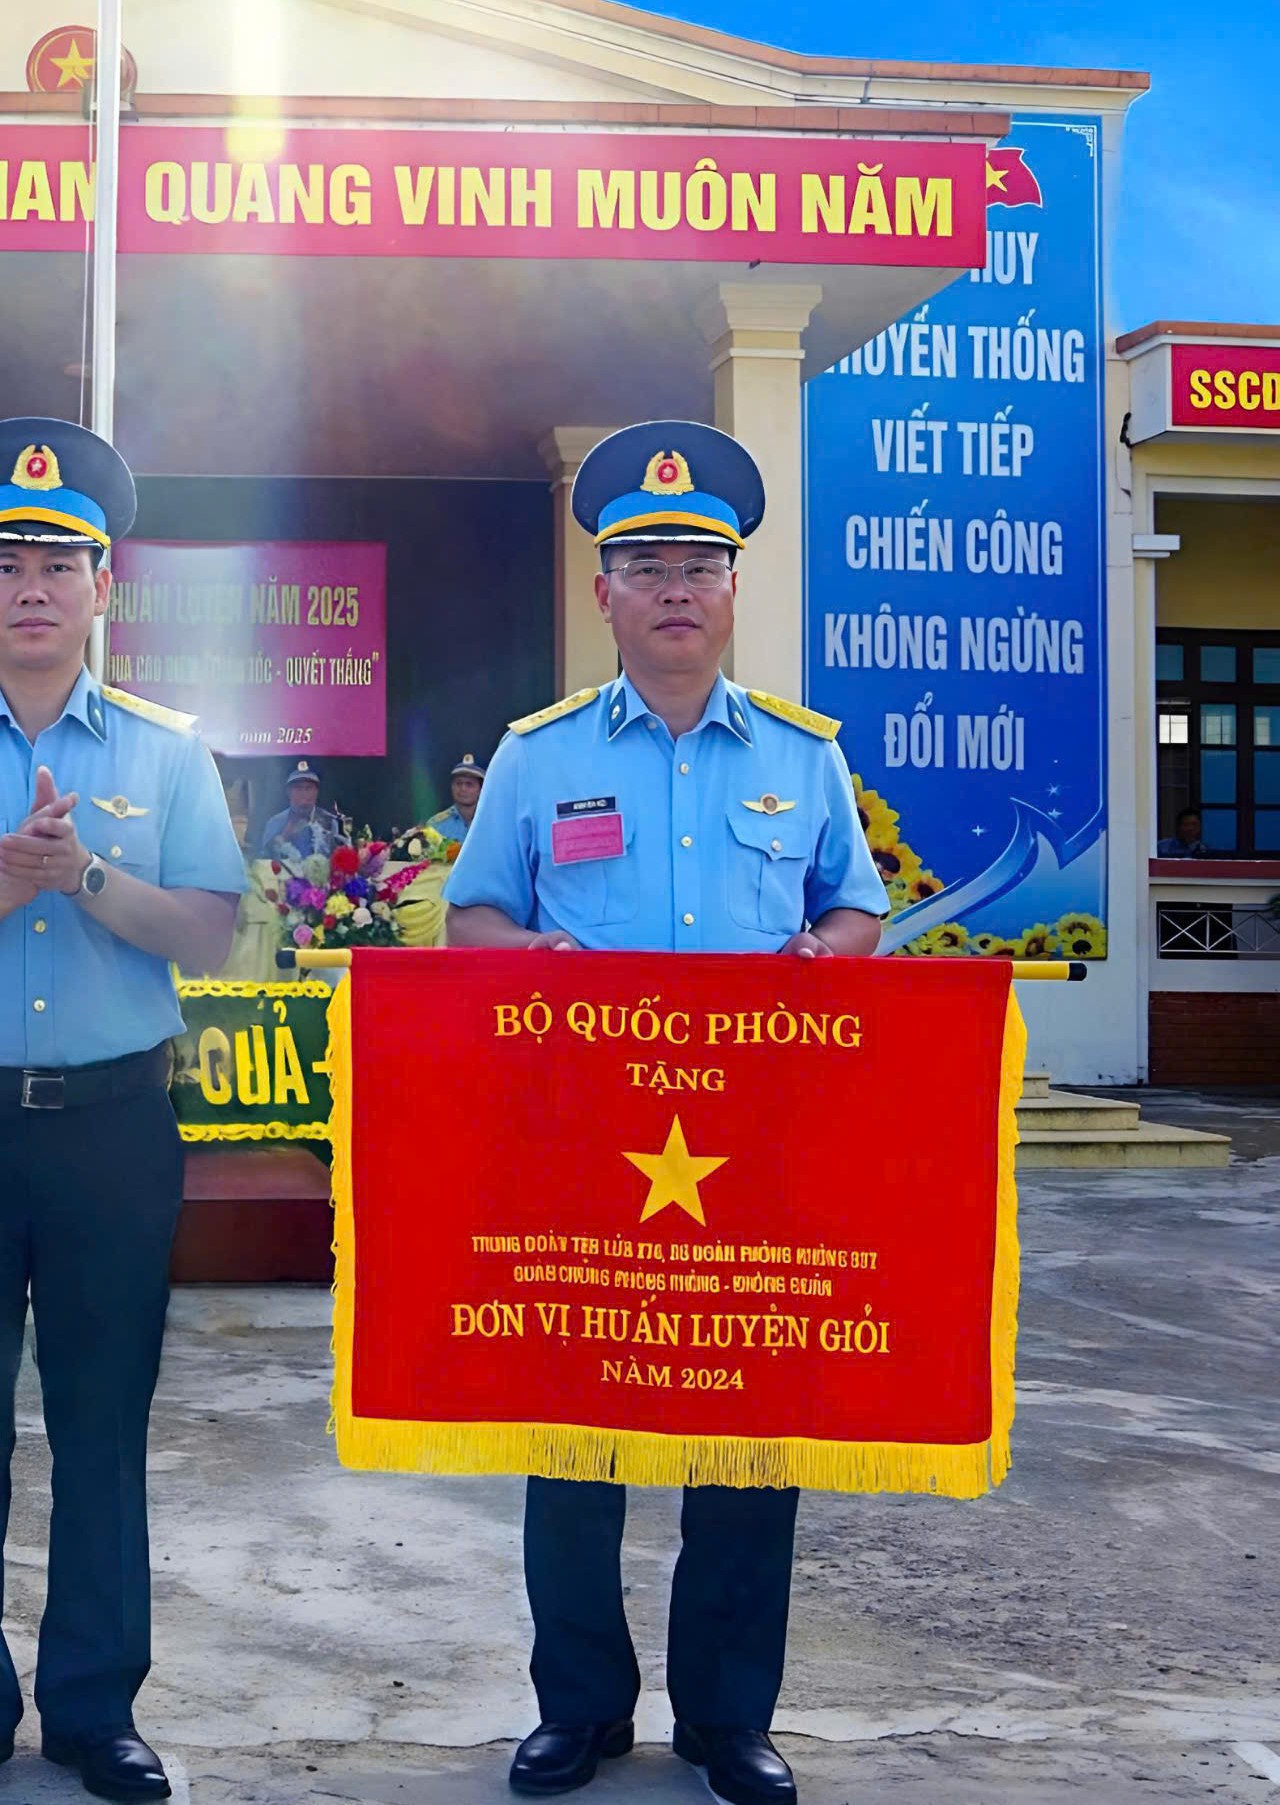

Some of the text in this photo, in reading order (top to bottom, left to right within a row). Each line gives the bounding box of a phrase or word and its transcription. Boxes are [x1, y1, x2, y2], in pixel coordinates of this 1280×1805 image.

[145, 161, 372, 226] QUANG
[394, 166, 553, 229] VINH
[577, 157, 777, 233] MUÔN
[801, 161, 954, 237] NĂM
[968, 308, 1085, 383] THỐNG
[871, 402, 1035, 477] VIẾT TIẾP
[845, 499, 1063, 576] CHIẾN CÔNG
[251, 575, 301, 626] NĂM
[307, 585, 360, 627] 2025
[824, 602, 1085, 675] KHÔNG NGỪNG
[884, 691, 1025, 771] ĐỔI MỚI
[493, 991, 864, 1048] BỘ QUỐC PHÒNG
[626, 1060, 726, 1096] TẶNG
[450, 1294, 891, 1356] ĐƠN VỊ HUẤN LUYỆN GIỎI
[681, 1367, 745, 1390] 2024
